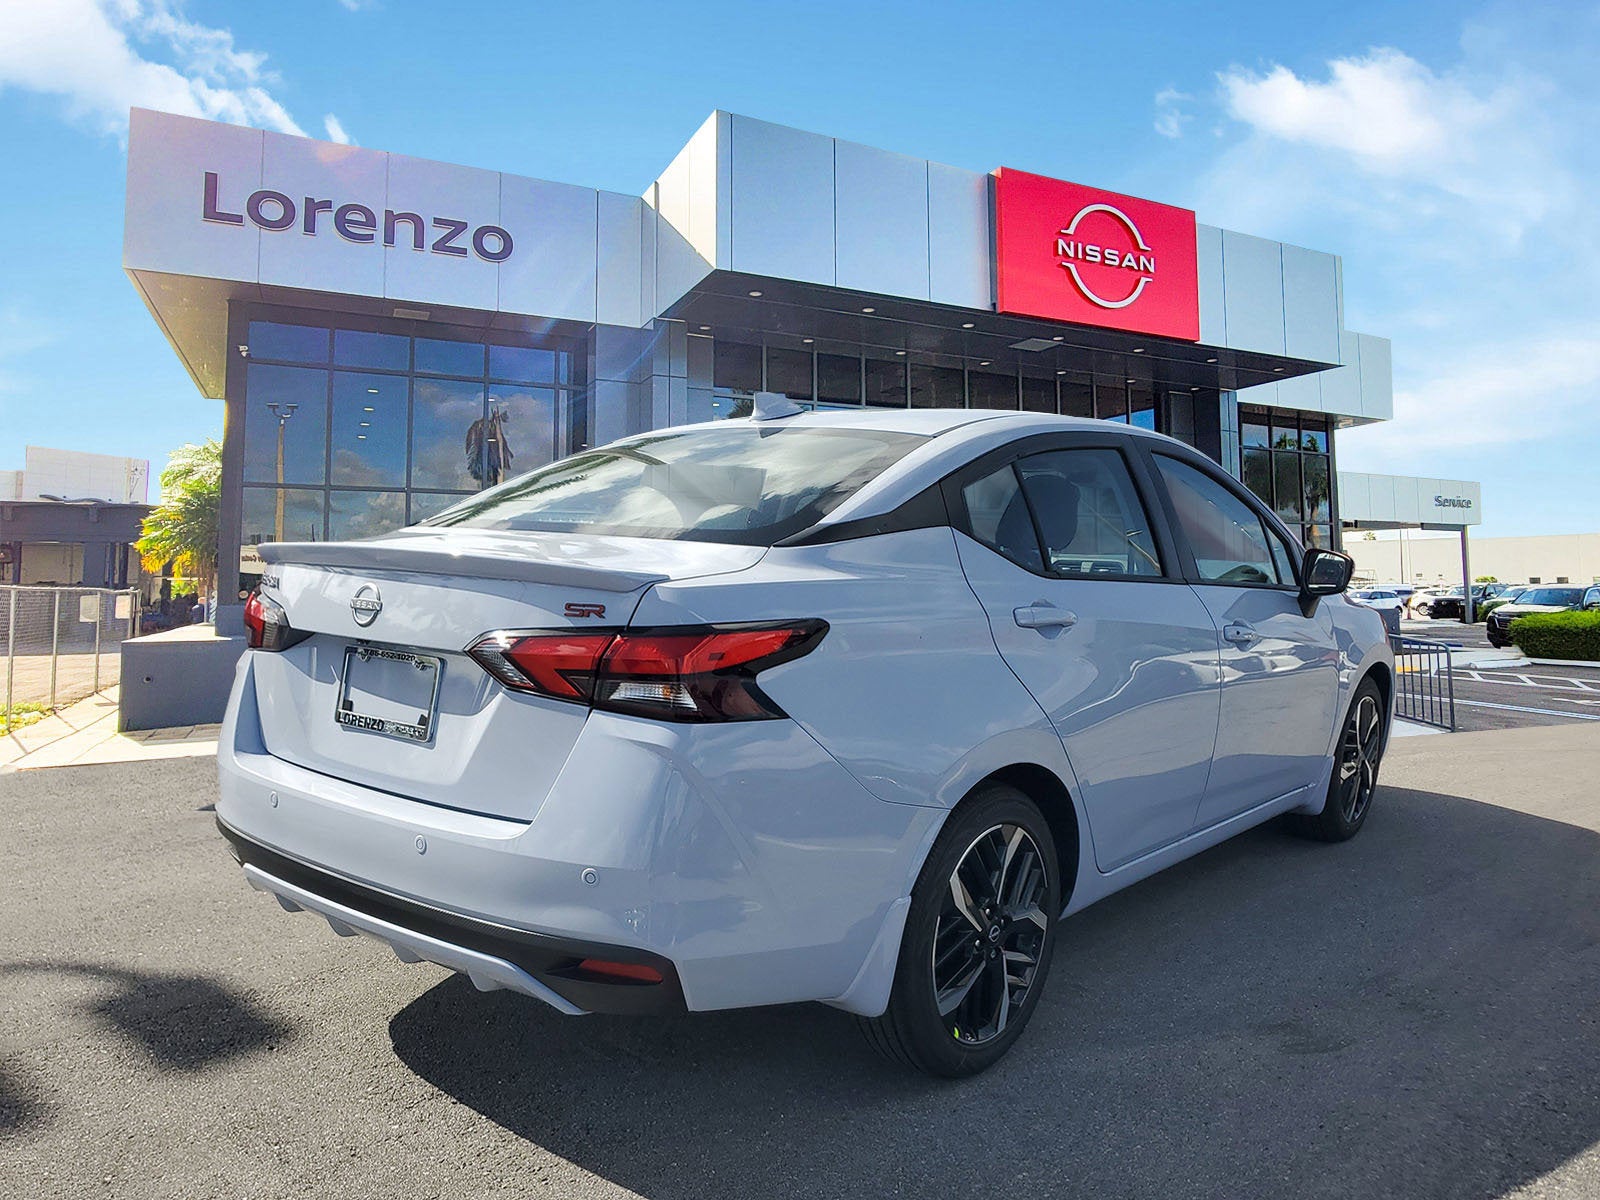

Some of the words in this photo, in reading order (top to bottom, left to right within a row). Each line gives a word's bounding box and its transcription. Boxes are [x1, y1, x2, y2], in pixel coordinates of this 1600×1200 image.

[202, 171, 514, 262] Lorenzo
[1057, 238, 1155, 273] NISSAN
[1433, 495, 1472, 509] Service
[563, 602, 606, 619] SR
[336, 711, 386, 731] LORENZO
